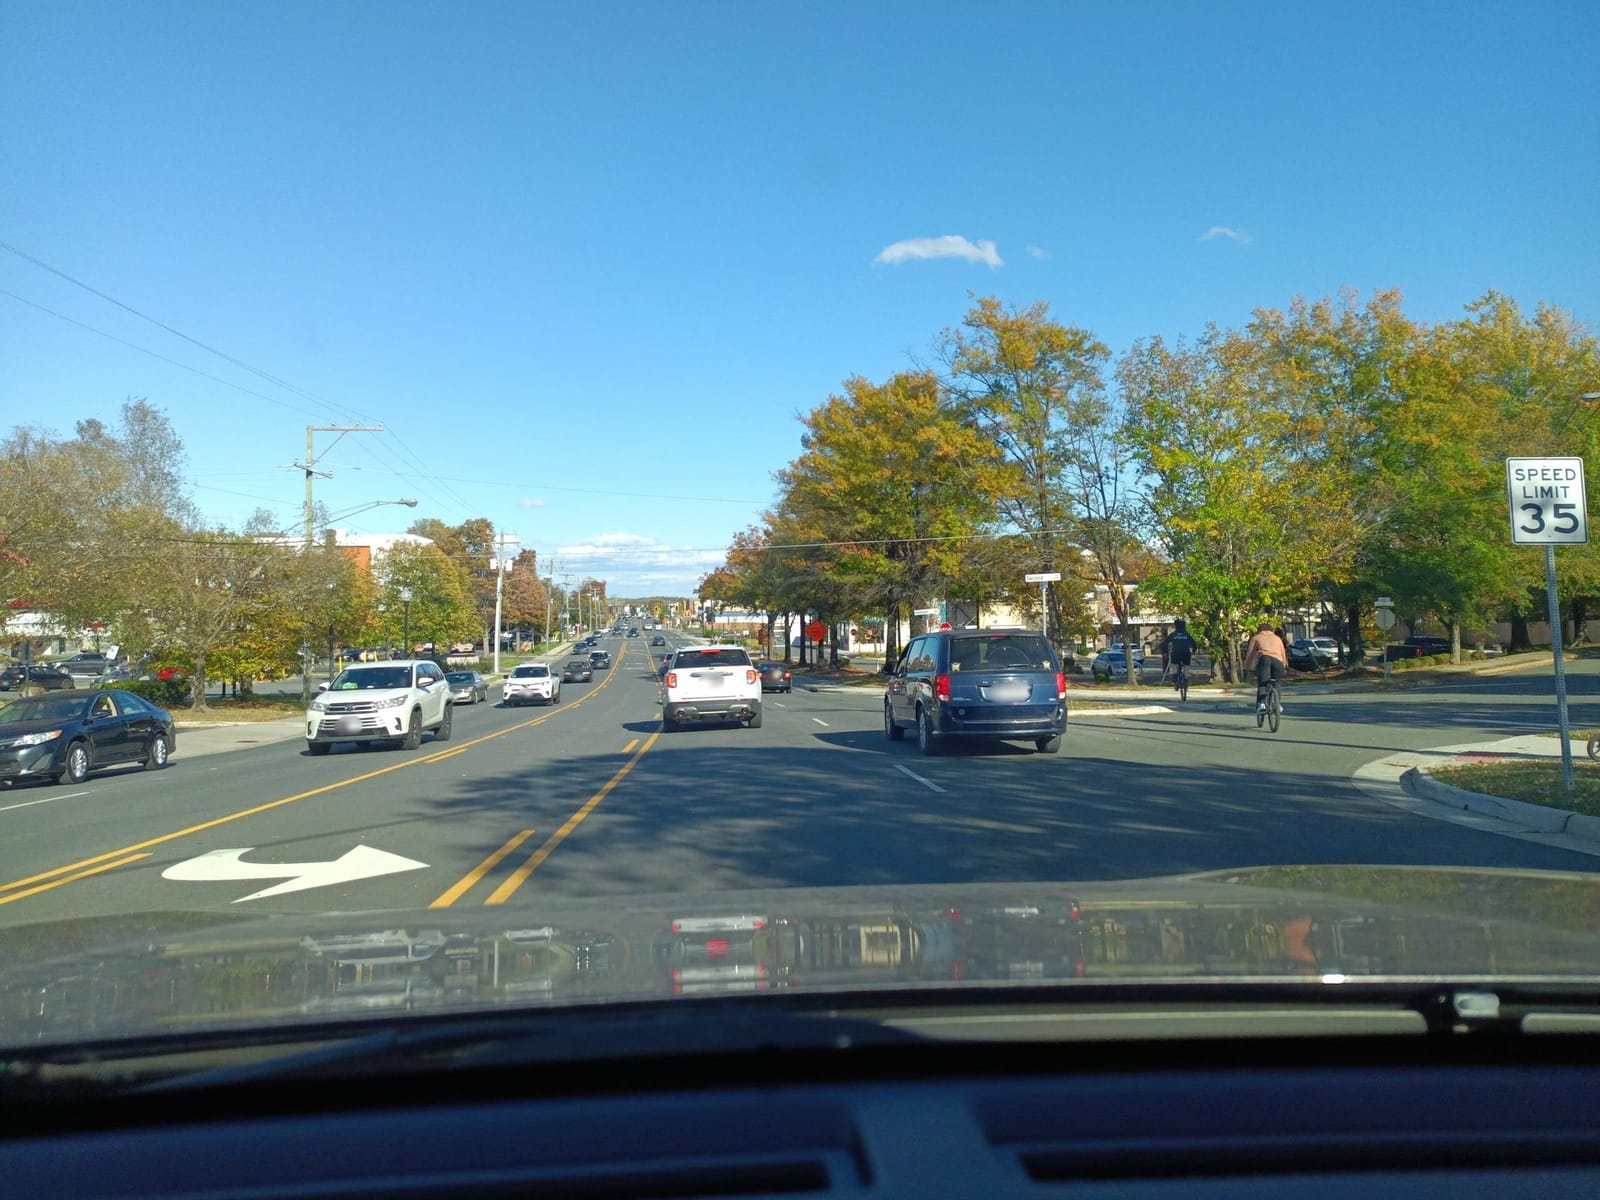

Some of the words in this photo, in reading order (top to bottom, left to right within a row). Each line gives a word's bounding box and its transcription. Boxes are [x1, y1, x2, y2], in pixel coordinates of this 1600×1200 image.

[1515, 468, 1576, 481] SPEED
[1523, 486, 1570, 498] LIMIT
[1520, 503, 1579, 534] 35
